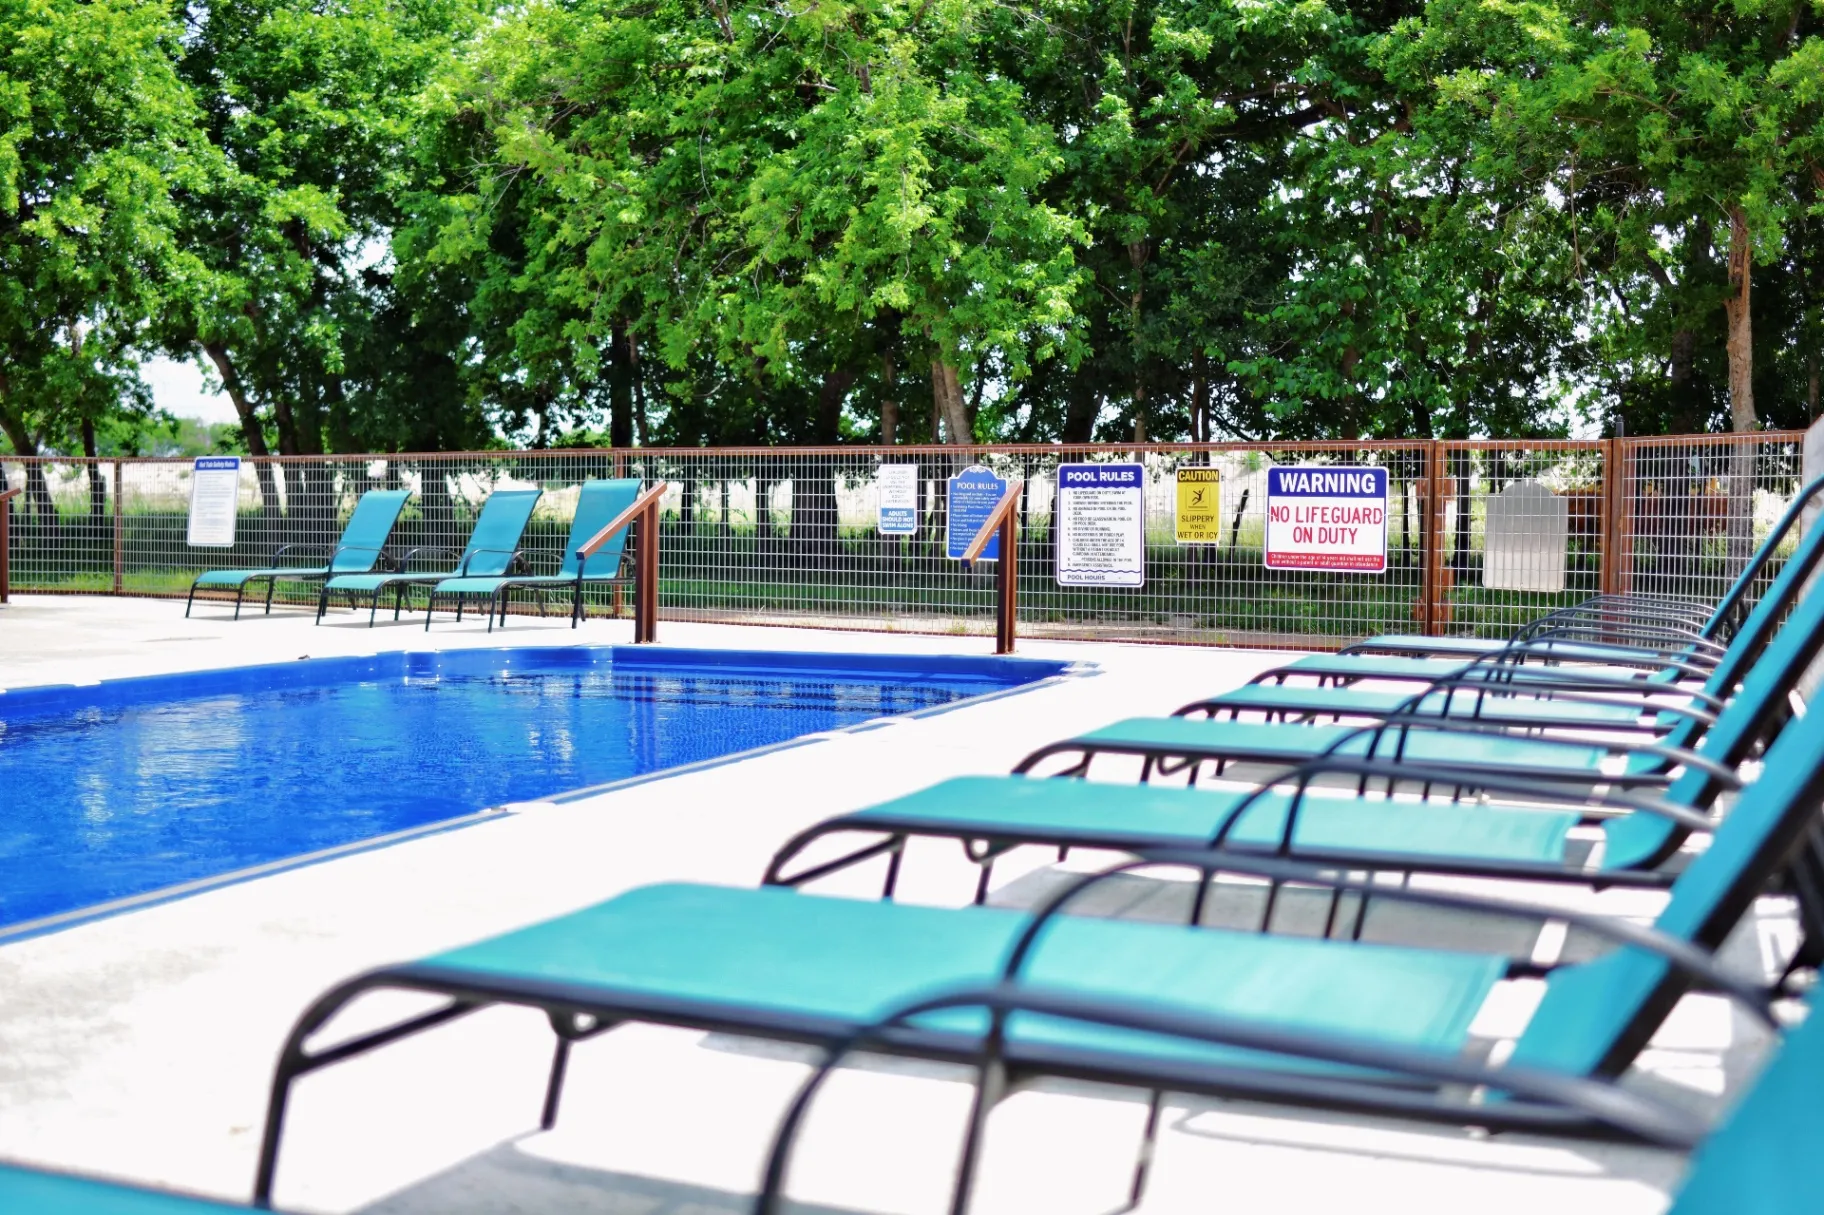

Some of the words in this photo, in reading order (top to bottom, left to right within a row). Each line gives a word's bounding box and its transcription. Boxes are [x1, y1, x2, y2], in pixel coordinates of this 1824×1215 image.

[1067, 472, 1097, 482] POOL
[1100, 472, 1135, 482] RULES
[1178, 470, 1218, 481] CAUTION
[1279, 472, 1376, 494] WARNING
[1270, 506, 1290, 523] NO
[1296, 506, 1383, 524] LIFEGUARD
[1293, 526, 1312, 543] ON
[1318, 527, 1358, 544] DUTY
